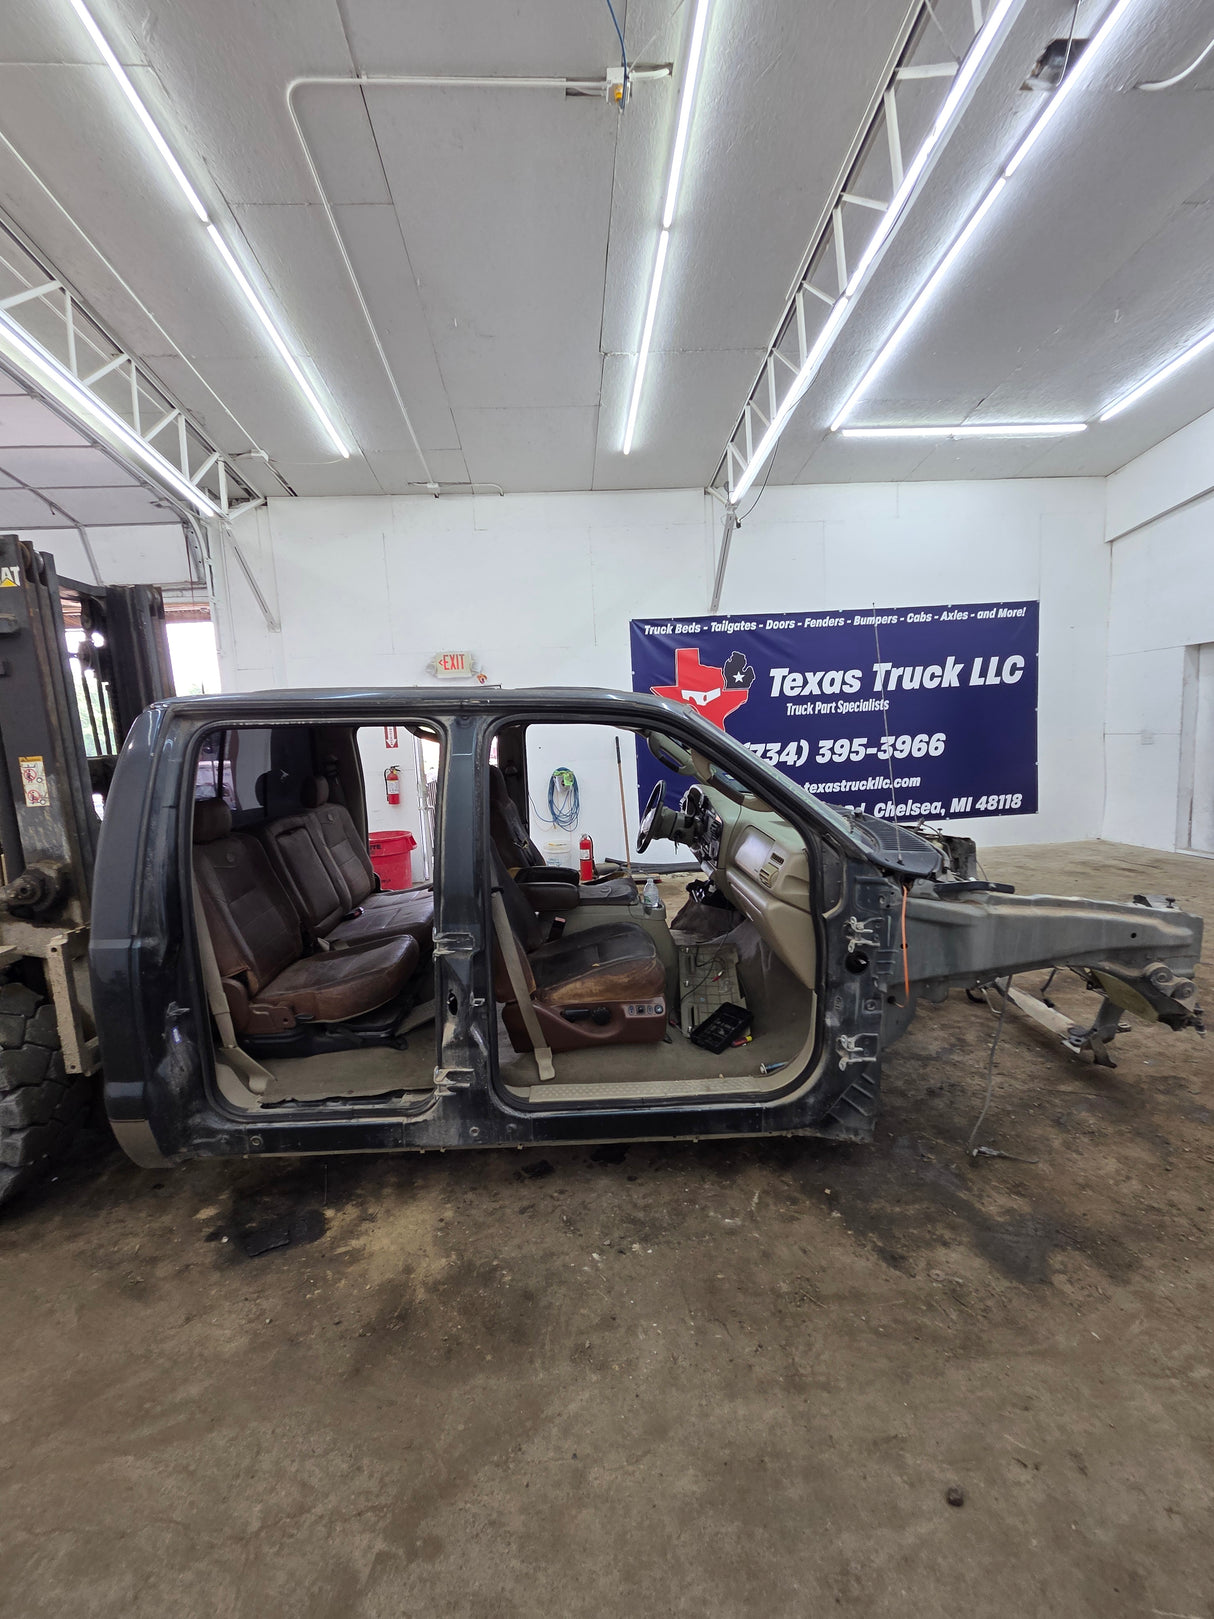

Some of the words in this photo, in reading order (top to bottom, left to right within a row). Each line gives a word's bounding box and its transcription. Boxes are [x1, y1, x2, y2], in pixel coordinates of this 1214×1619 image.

[0, 566, 21, 587] AT
[644, 624, 673, 635] Truck
[675, 622, 701, 634] Beds
[710, 621, 757, 634] Tailgates
[765, 619, 795, 630] Doors
[804, 617, 845, 628] Fenders
[853, 614, 898, 626] Bumpers
[906, 611, 932, 623] Cabs
[940, 609, 968, 621] Axles
[977, 608, 996, 619] and
[997, 607, 1027, 618] More!
[443, 653, 465, 671] EXIT
[769, 667, 863, 697] Texas
[872, 656, 965, 692] Truck
[969, 654, 1025, 686] LLC
[786, 702, 814, 716] Truck
[815, 701, 836, 715] Part
[837, 698, 890, 714] Specialists
[815, 732, 946, 764] 395-3966
[803, 776, 921, 794] texastruckllc.com
[873, 799, 946, 818] Chelsea,
[949, 796, 973, 813] MI
[975, 793, 1023, 811] 48118
